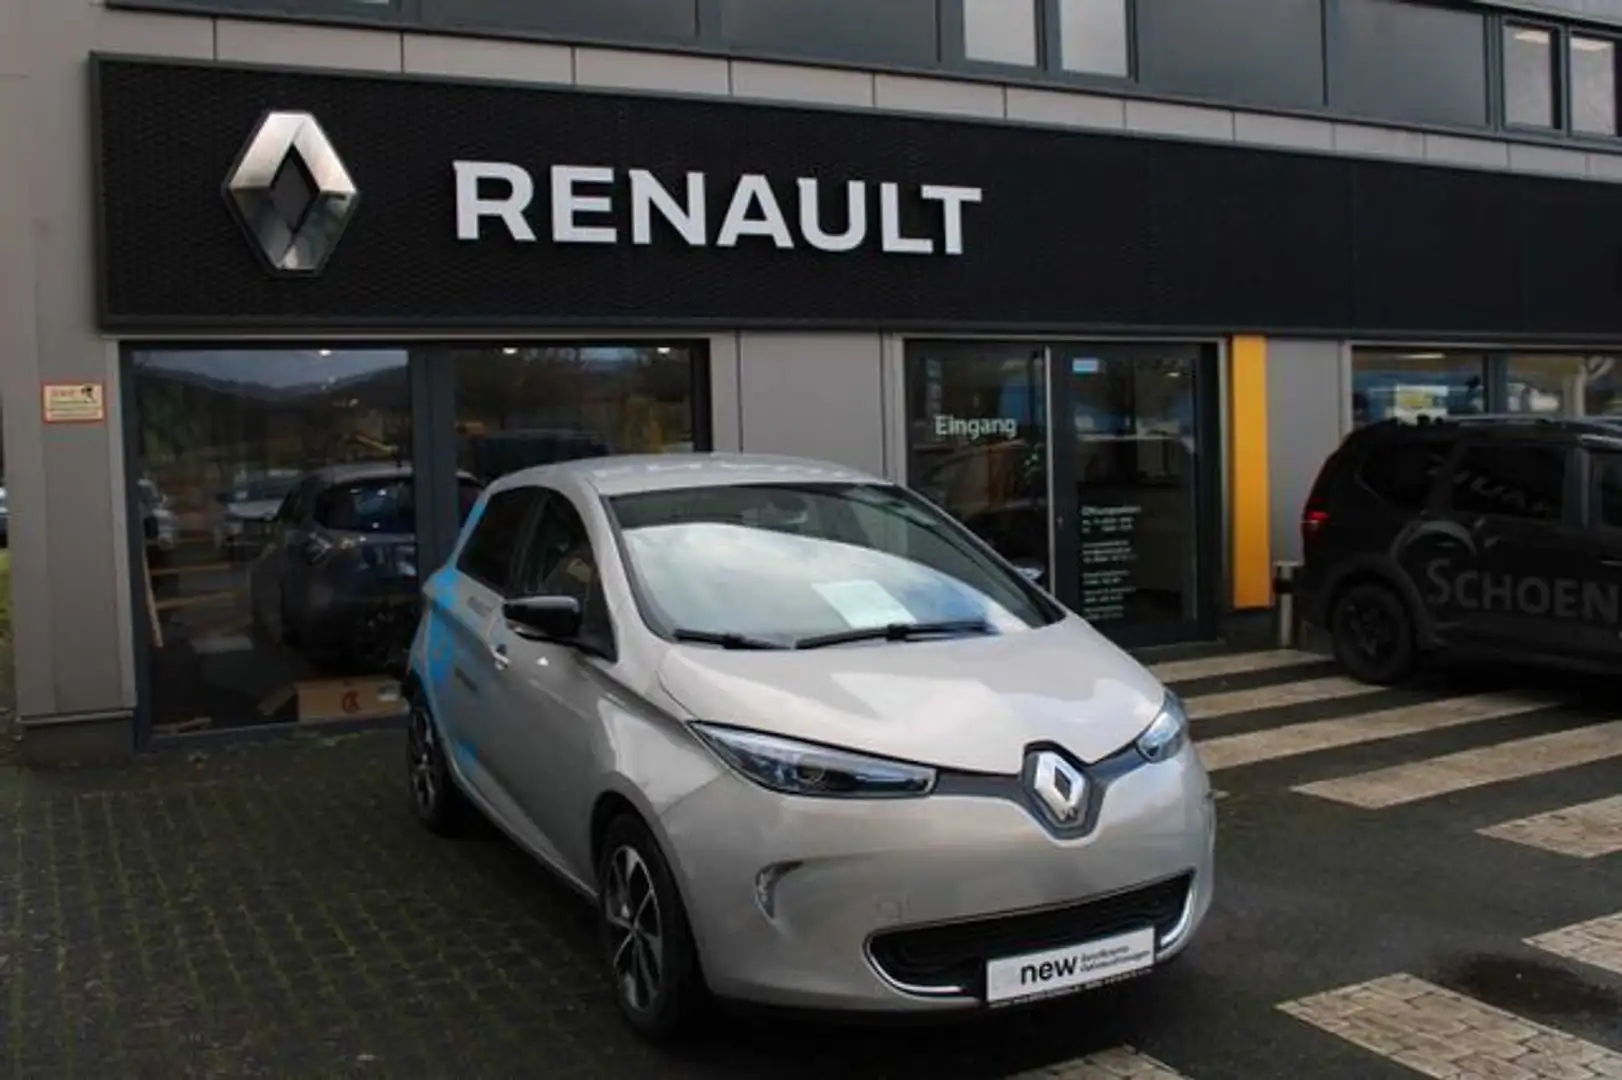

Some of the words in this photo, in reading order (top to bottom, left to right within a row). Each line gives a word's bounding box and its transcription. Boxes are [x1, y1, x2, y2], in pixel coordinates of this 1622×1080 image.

[453, 160, 982, 255] RENAULT
[934, 414, 1017, 441] Eingang
[1020, 957, 1077, 984] new
